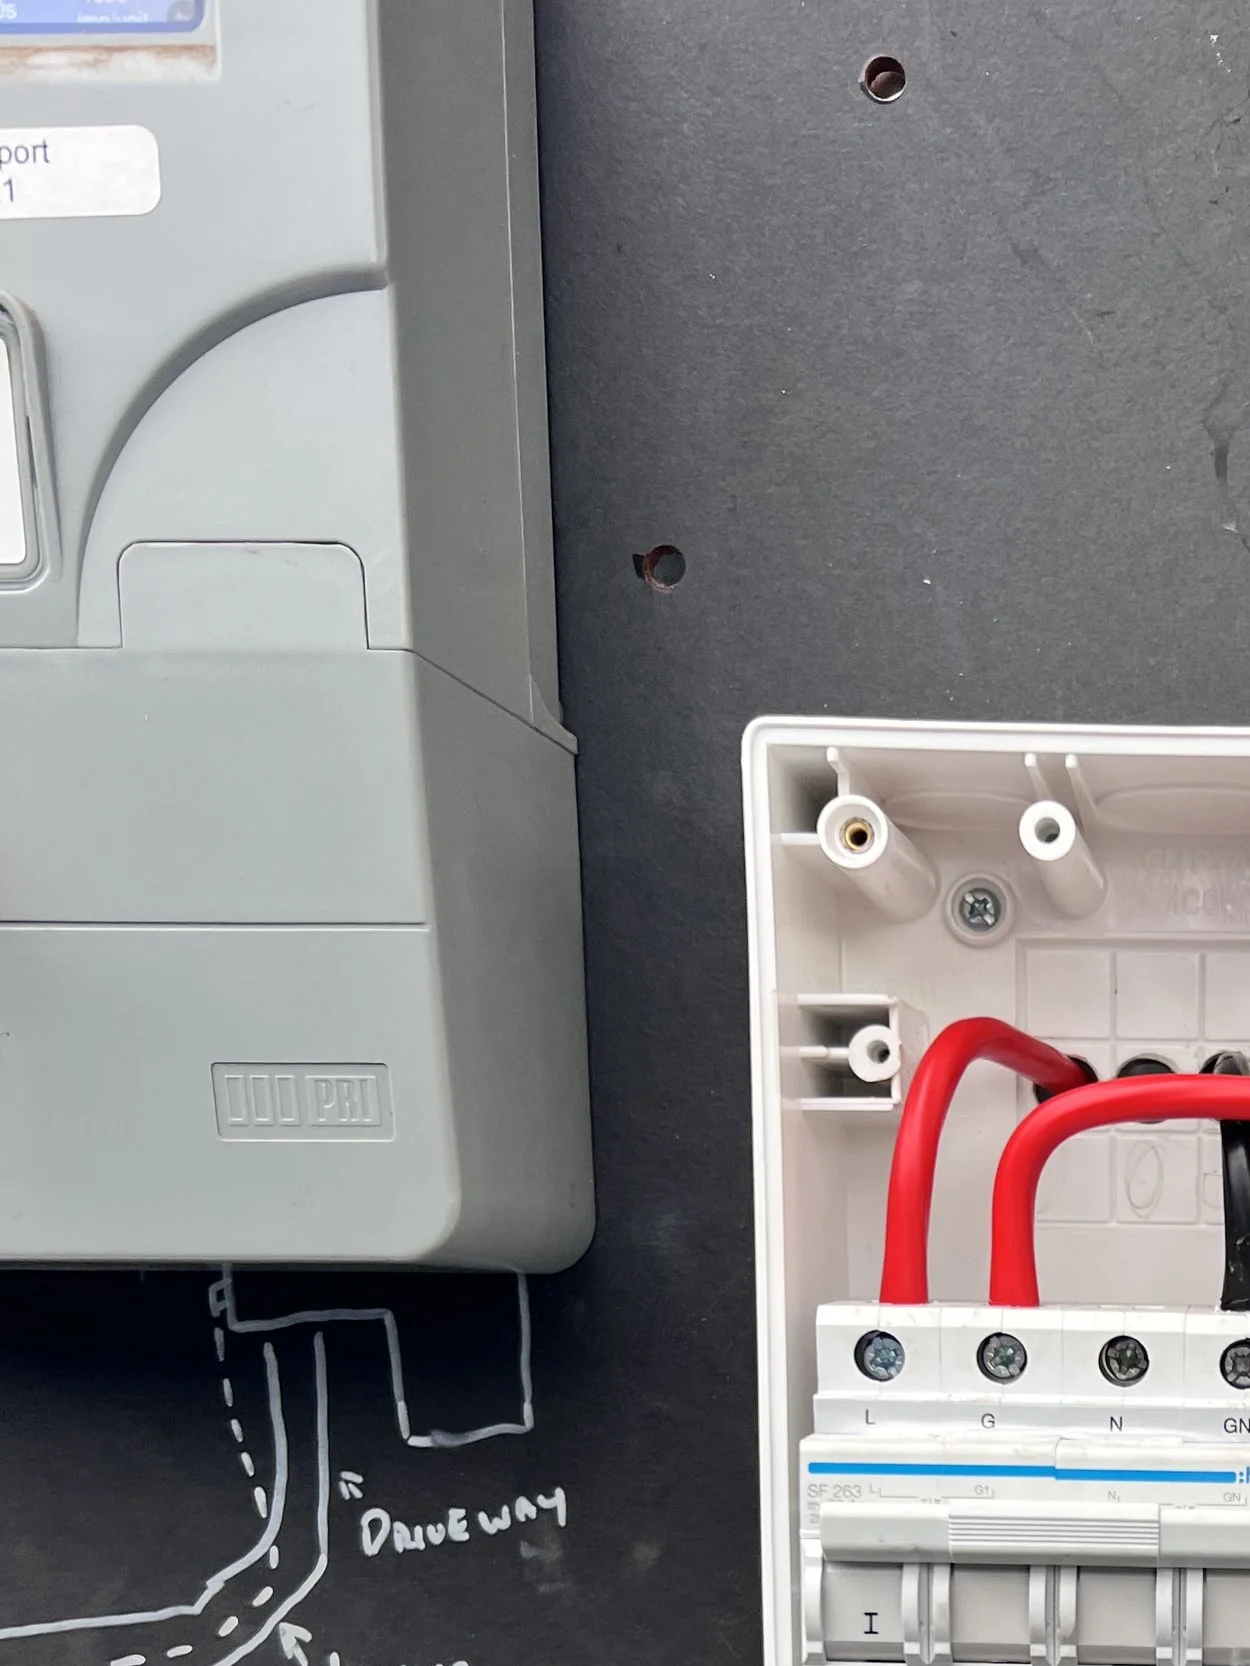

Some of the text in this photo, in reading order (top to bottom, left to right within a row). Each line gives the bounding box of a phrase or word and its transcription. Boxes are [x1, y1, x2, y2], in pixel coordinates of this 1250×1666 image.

[314, 1079, 373, 1122] PRI
[865, 1409, 1250, 1433] L G N GN
